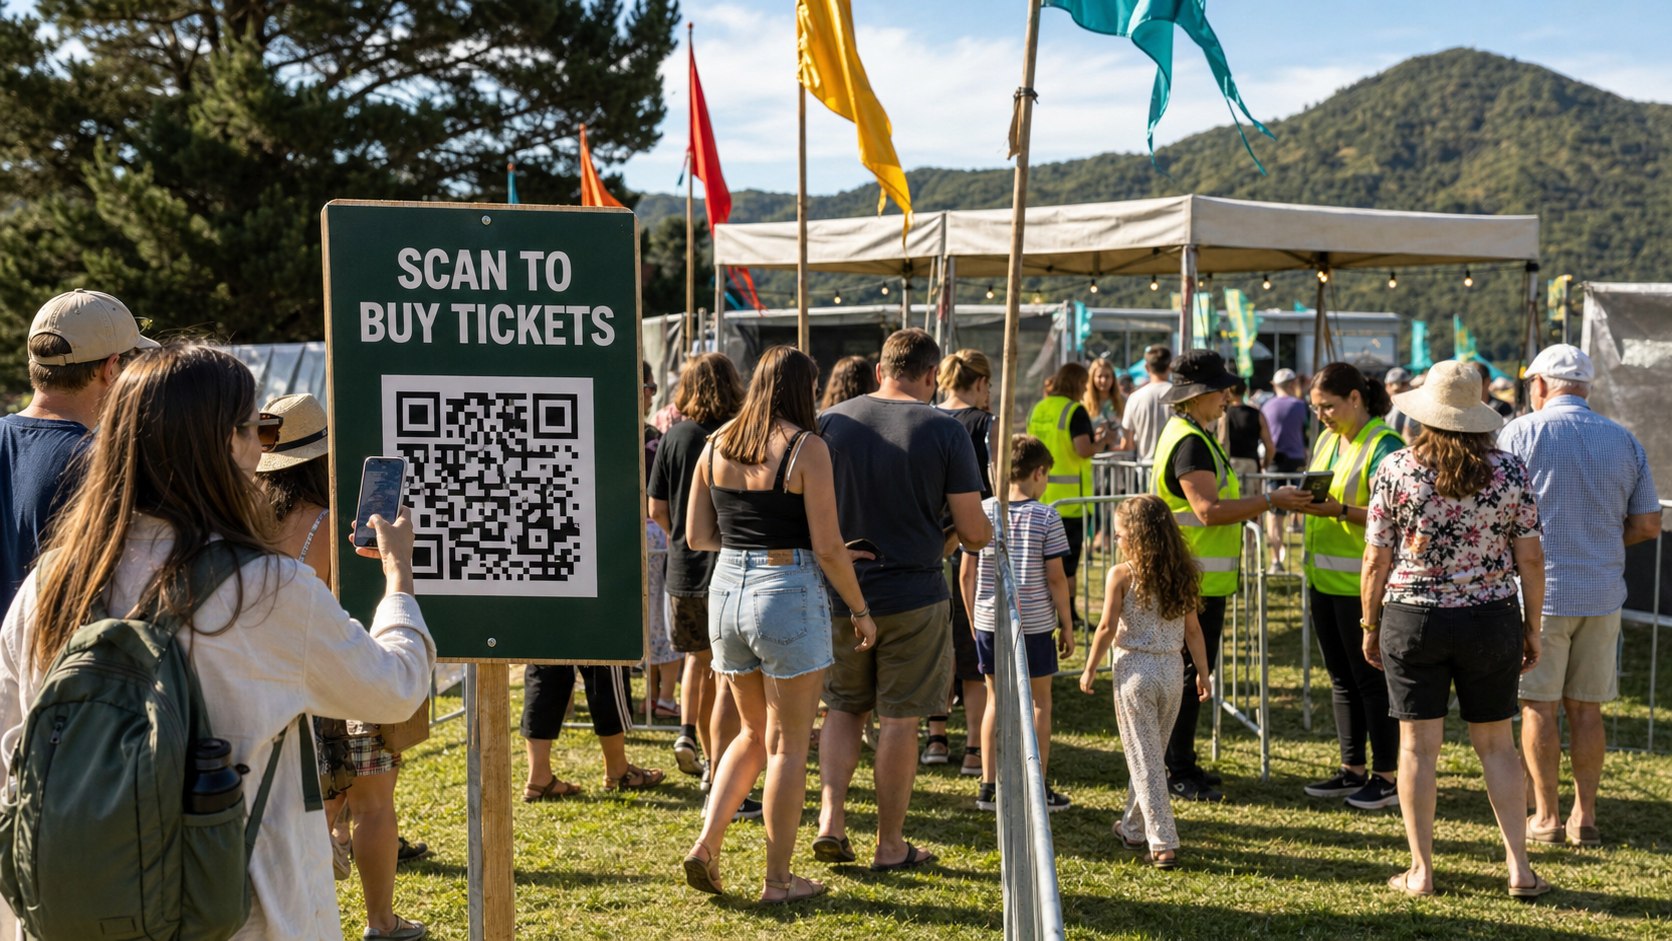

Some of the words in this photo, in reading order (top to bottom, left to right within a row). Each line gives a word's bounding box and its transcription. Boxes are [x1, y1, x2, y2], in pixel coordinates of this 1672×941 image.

[397, 247, 507, 290] SCAN
[519, 250, 572, 292] TO
[359, 301, 440, 343] BUY
[450, 303, 616, 347] TICKETS
